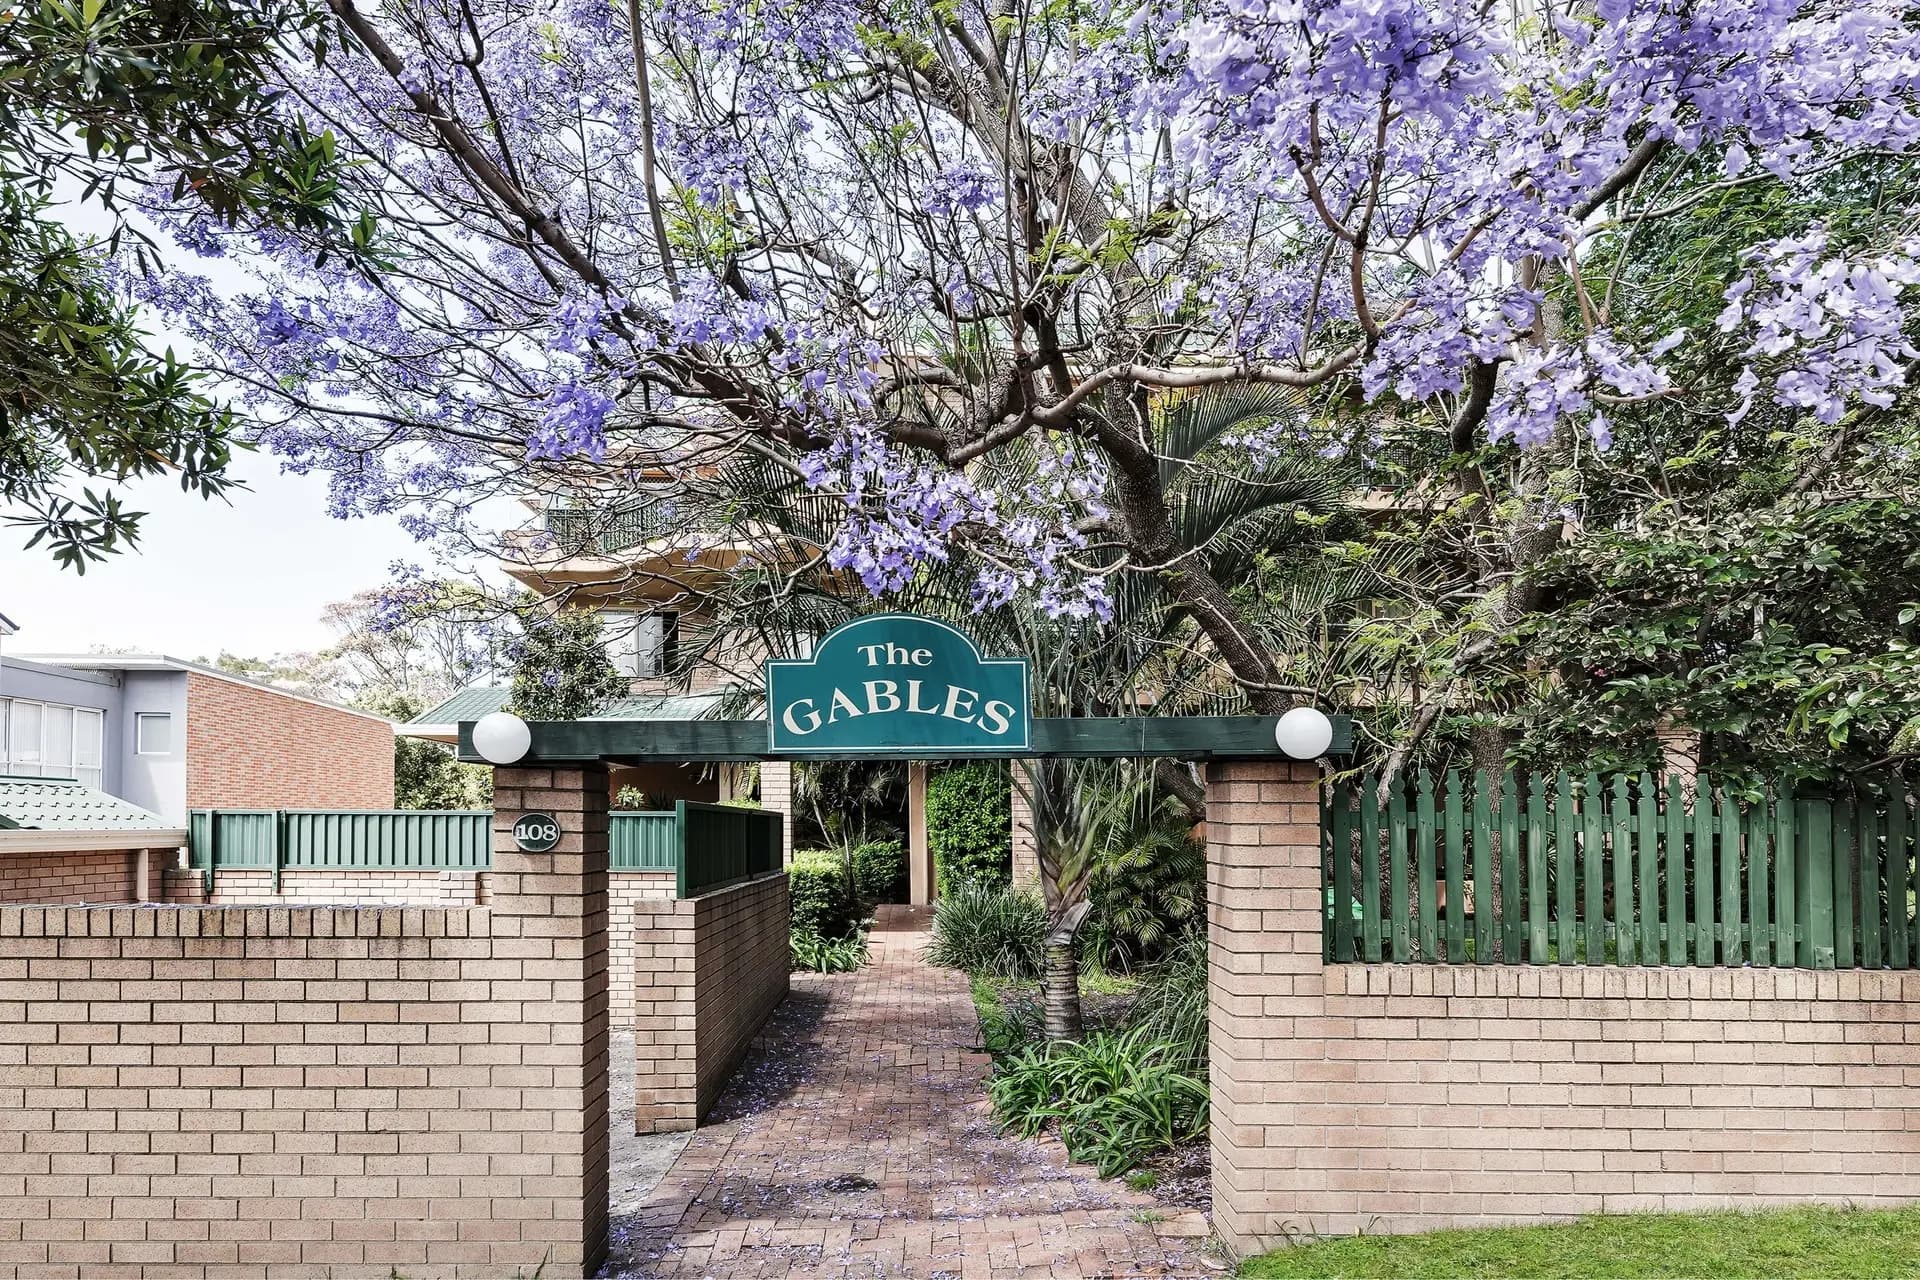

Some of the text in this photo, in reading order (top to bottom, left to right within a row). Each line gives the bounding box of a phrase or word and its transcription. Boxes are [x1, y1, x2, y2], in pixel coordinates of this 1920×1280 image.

[857, 642, 933, 666] The
[782, 679, 1016, 735] GABLES
[515, 823, 557, 841] 108
